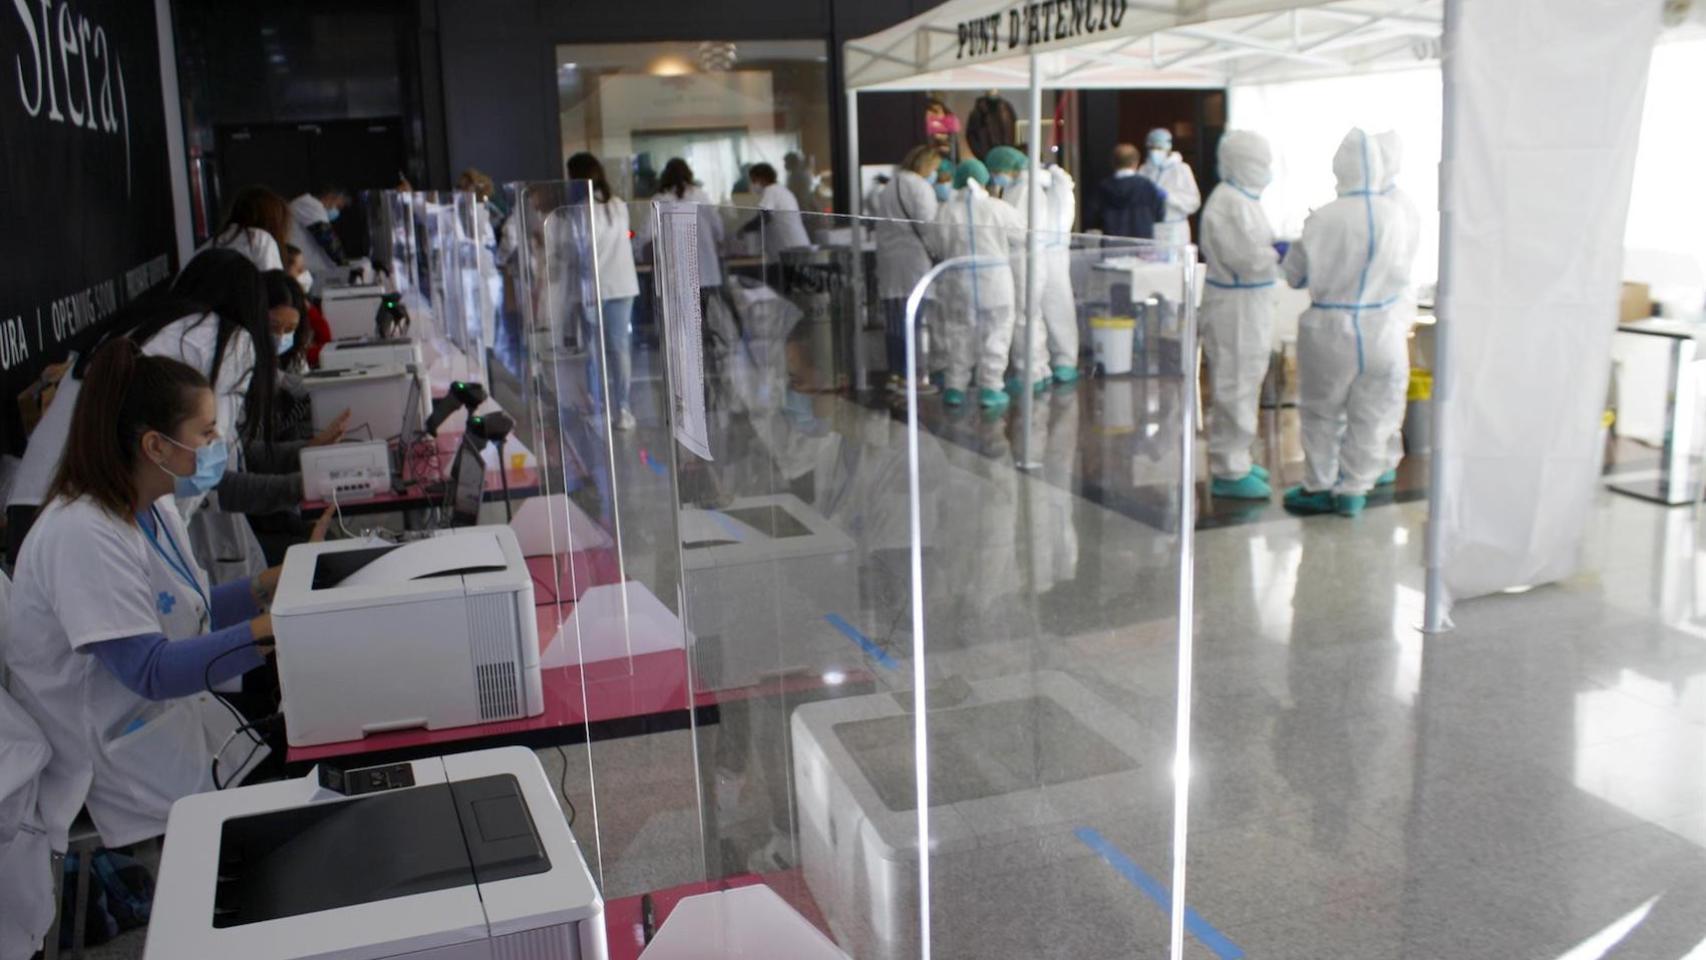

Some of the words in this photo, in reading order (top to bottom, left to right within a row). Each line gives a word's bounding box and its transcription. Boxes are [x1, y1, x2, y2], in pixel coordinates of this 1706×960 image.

[957, 13, 1001, 59] PUNT
[0, 315, 30, 370] URA
[51, 285, 95, 343] OPENING
